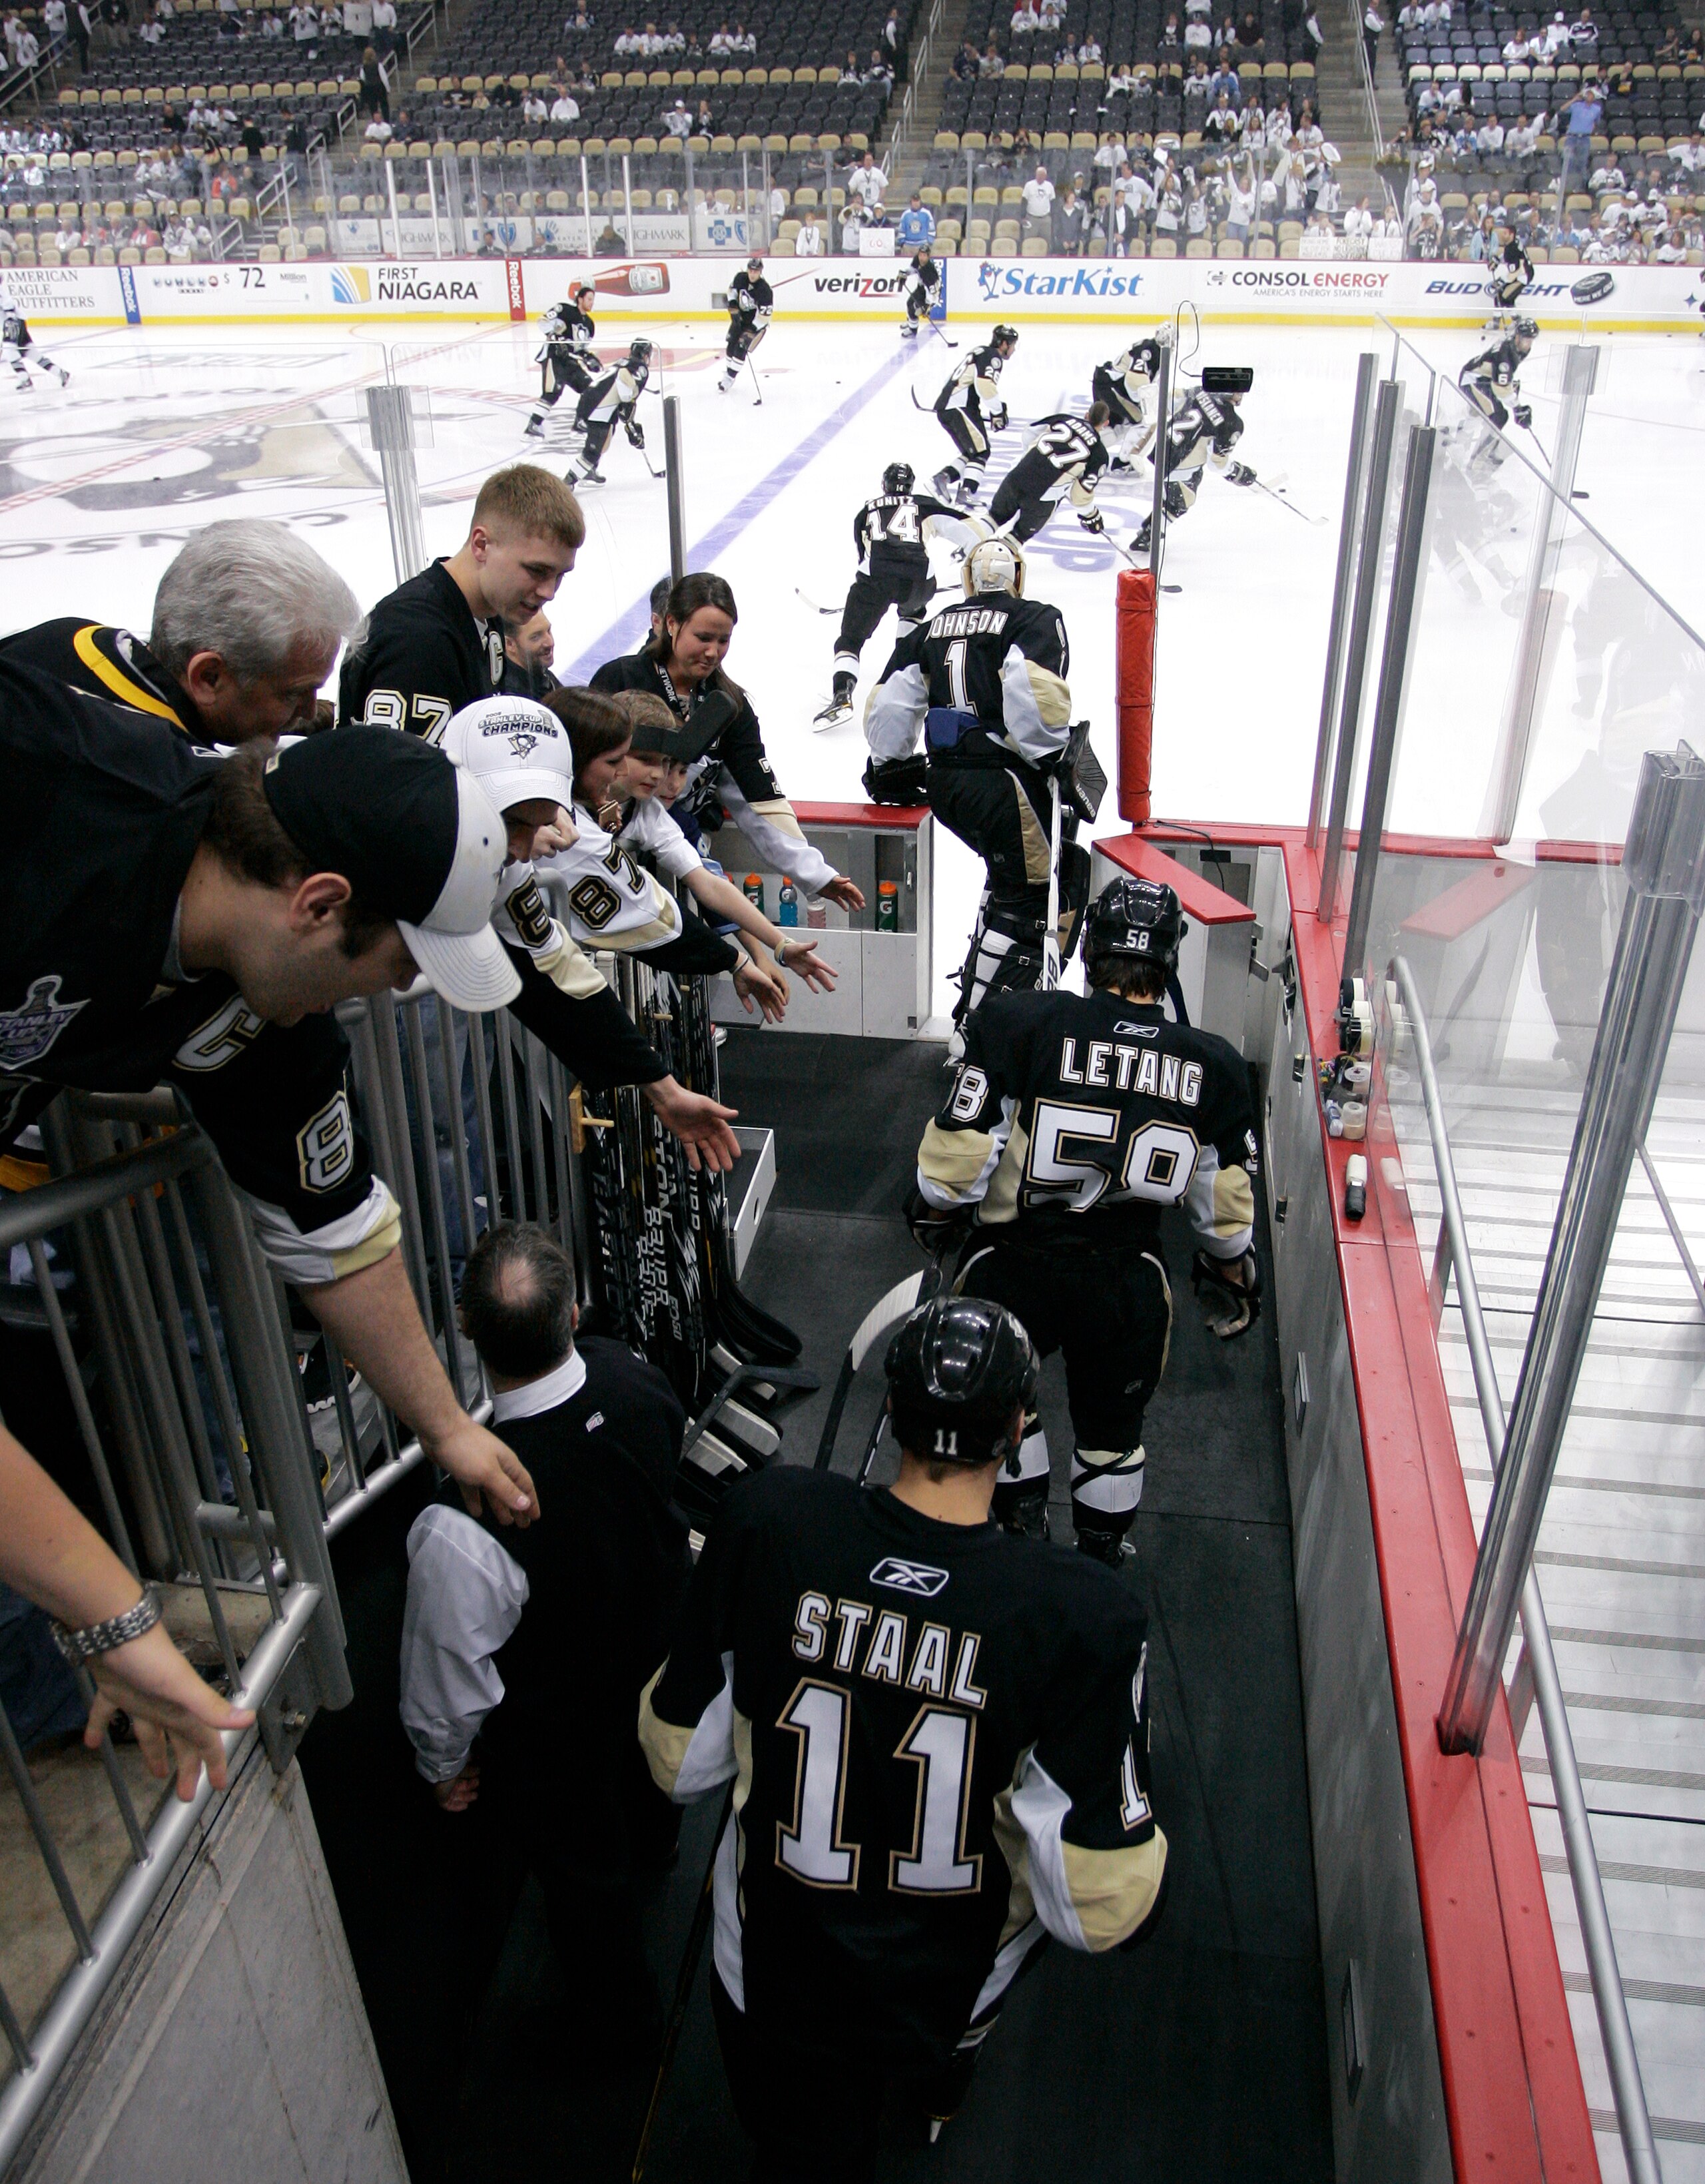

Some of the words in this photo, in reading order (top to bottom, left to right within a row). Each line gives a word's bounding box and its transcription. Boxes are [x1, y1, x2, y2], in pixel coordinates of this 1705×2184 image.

[6, 270, 79, 282] AMERICAN
[239, 266, 266, 288] 72
[378, 268, 418, 280] FIRST
[508, 261, 522, 309] Reebok
[814, 270, 904, 297] verizon
[1002, 266, 1144, 296] StarKist
[1232, 272, 1309, 286] CONSOL
[1313, 272, 1389, 287] ENERGY
[8, 284, 53, 296] EAGLE
[378, 281, 479, 300] NIAGARA
[1252, 288, 1297, 297] AMERICA'S
[1299, 288, 1331, 297] ENERGY
[1333, 289, 1361, 298] STARTS
[1363, 289, 1384, 298] HERE
[1425, 280, 1482, 294] BUD
[1066, 418, 1098, 446] ADAMS
[1036, 422, 1091, 470] 27
[867, 495, 916, 512] KUNITZ
[866, 504, 920, 544] 14
[943, 638, 980, 717] 1
[364, 689, 454, 749] 87
[478, 714, 522, 729] STANLEY
[523, 713, 543, 723] CUP
[482, 721, 559, 739] CHAMPIONS
[879, 900, 892, 914] G
[1126, 929, 1149, 950] 58
[1060, 1037, 1203, 1107] LETANG
[934, 1429, 958, 1456] 11
[791, 1590, 988, 1710] STAAL
[774, 1676, 984, 1897] 11
